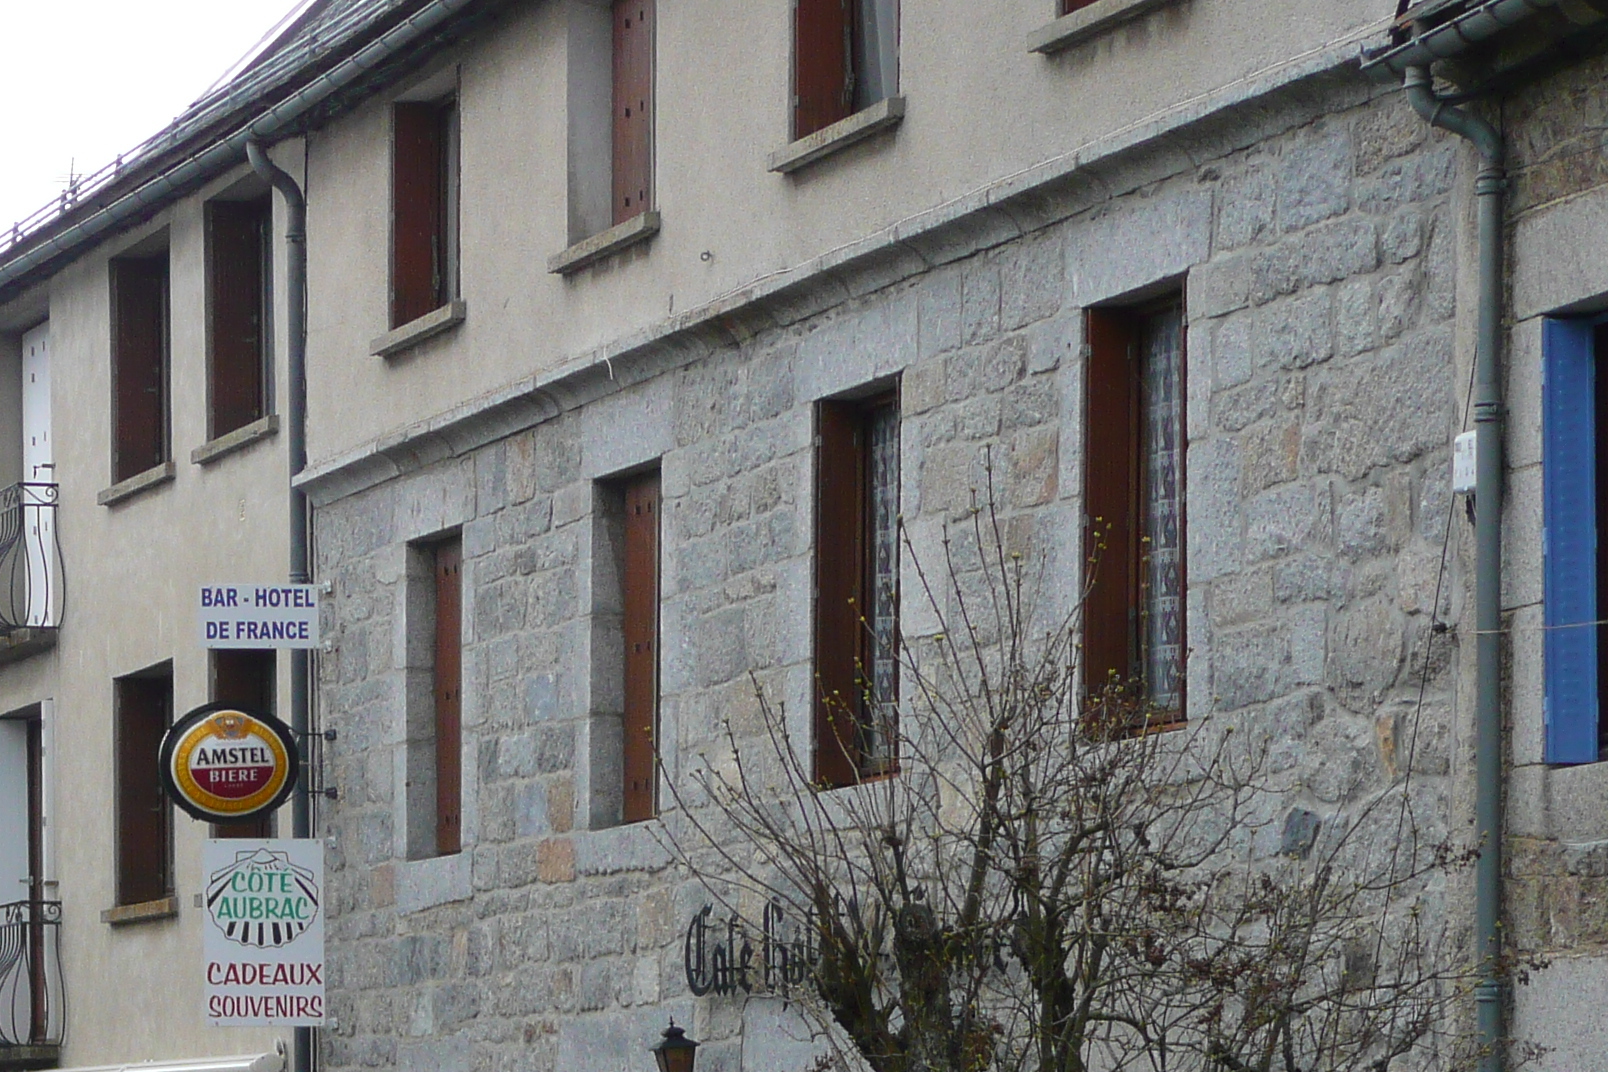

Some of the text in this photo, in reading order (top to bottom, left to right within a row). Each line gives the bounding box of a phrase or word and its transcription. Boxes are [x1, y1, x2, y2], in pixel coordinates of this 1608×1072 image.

[201, 588, 238, 607] BAR
[254, 588, 315, 608] HOTEL
[206, 621, 309, 640] DE FRANCE
[196, 746, 270, 766] AMSTEL
[209, 768, 258, 783] BIERE
[217, 897, 310, 920] AUBRAC
[207, 962, 323, 987] CADEAUX
[208, 994, 323, 1018] SOUVENIRS
